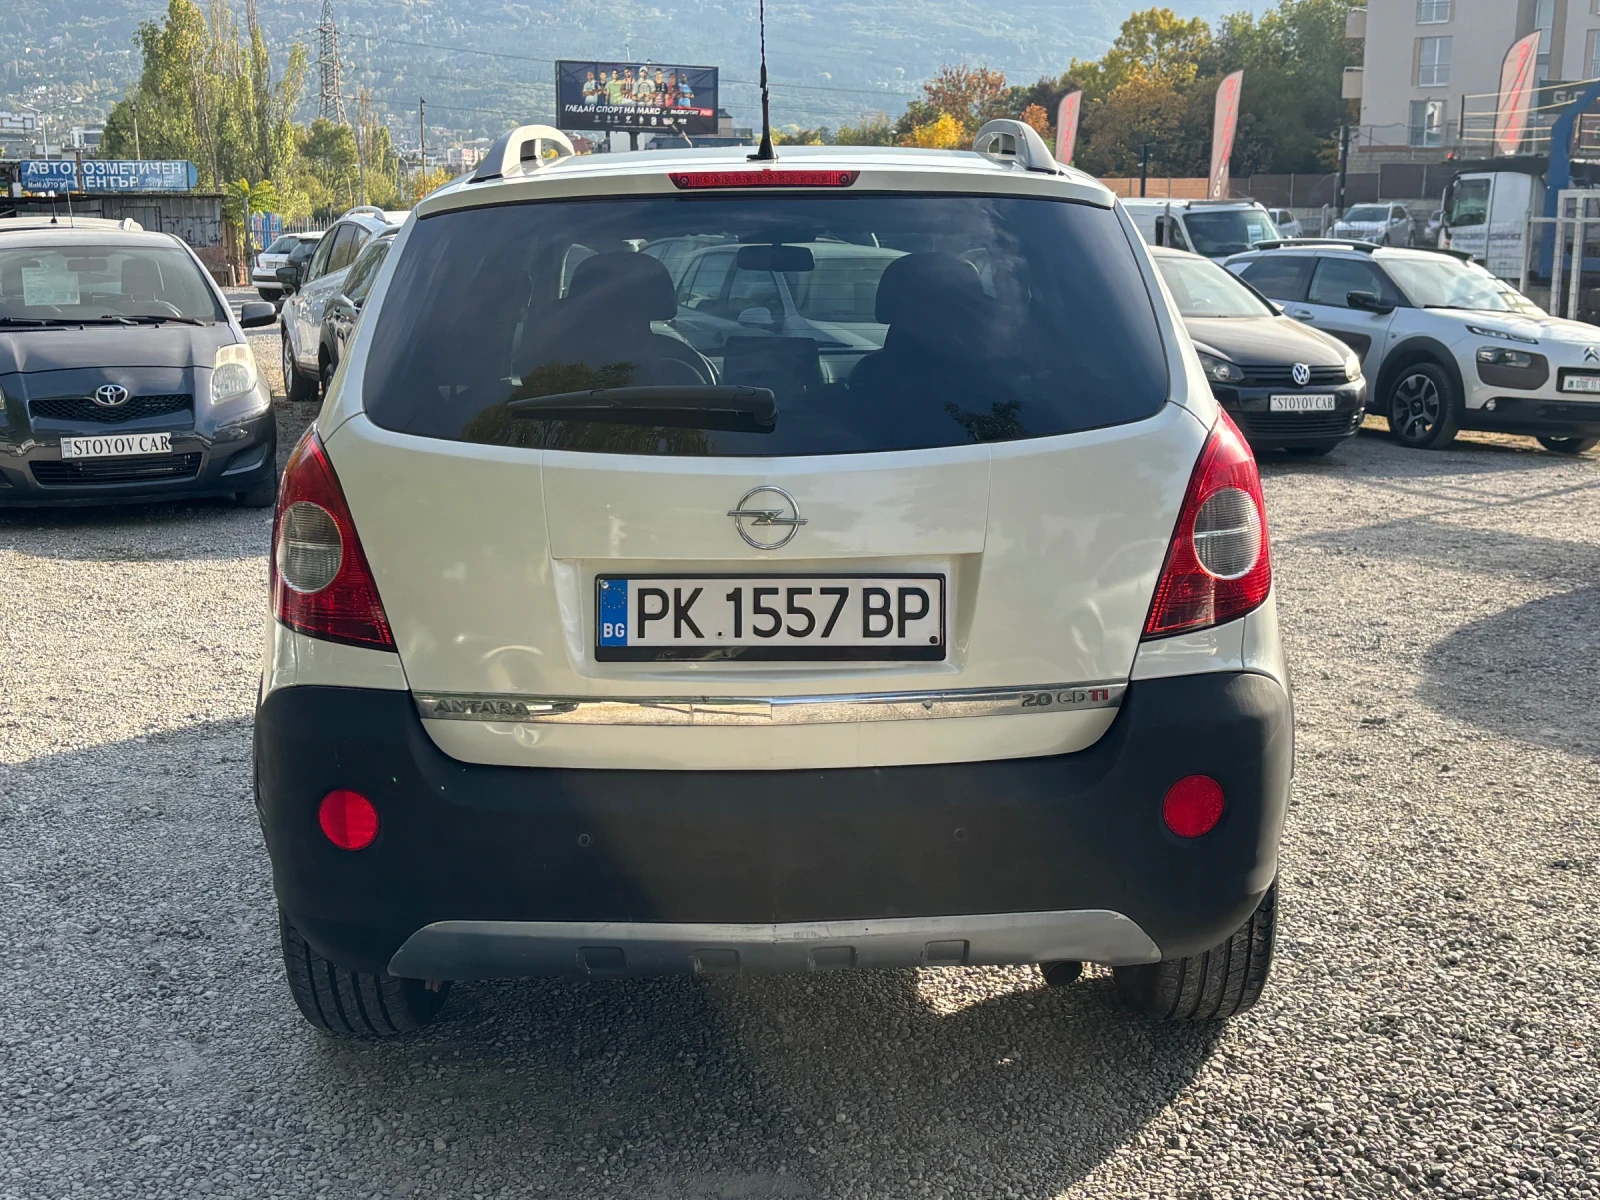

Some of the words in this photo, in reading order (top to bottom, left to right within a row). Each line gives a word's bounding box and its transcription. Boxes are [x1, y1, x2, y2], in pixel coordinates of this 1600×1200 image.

[565, 104, 594, 113] ГЛЕДАЙ
[624, 106, 635, 114] НА
[74, 175, 139, 190] ЦЕНТЪР
[1278, 397, 1313, 409] STOYOV
[1315, 397, 1333, 408] CAR
[74, 438, 134, 455] STOYOV
[139, 436, 169, 452] CAR
[637, 587, 705, 638] PK
[725, 587, 849, 638] 1557
[862, 587, 929, 638] BP
[603, 623, 625, 638] BG
[1057, 688, 1108, 704] CDTI
[433, 700, 531, 715] ANTARA
